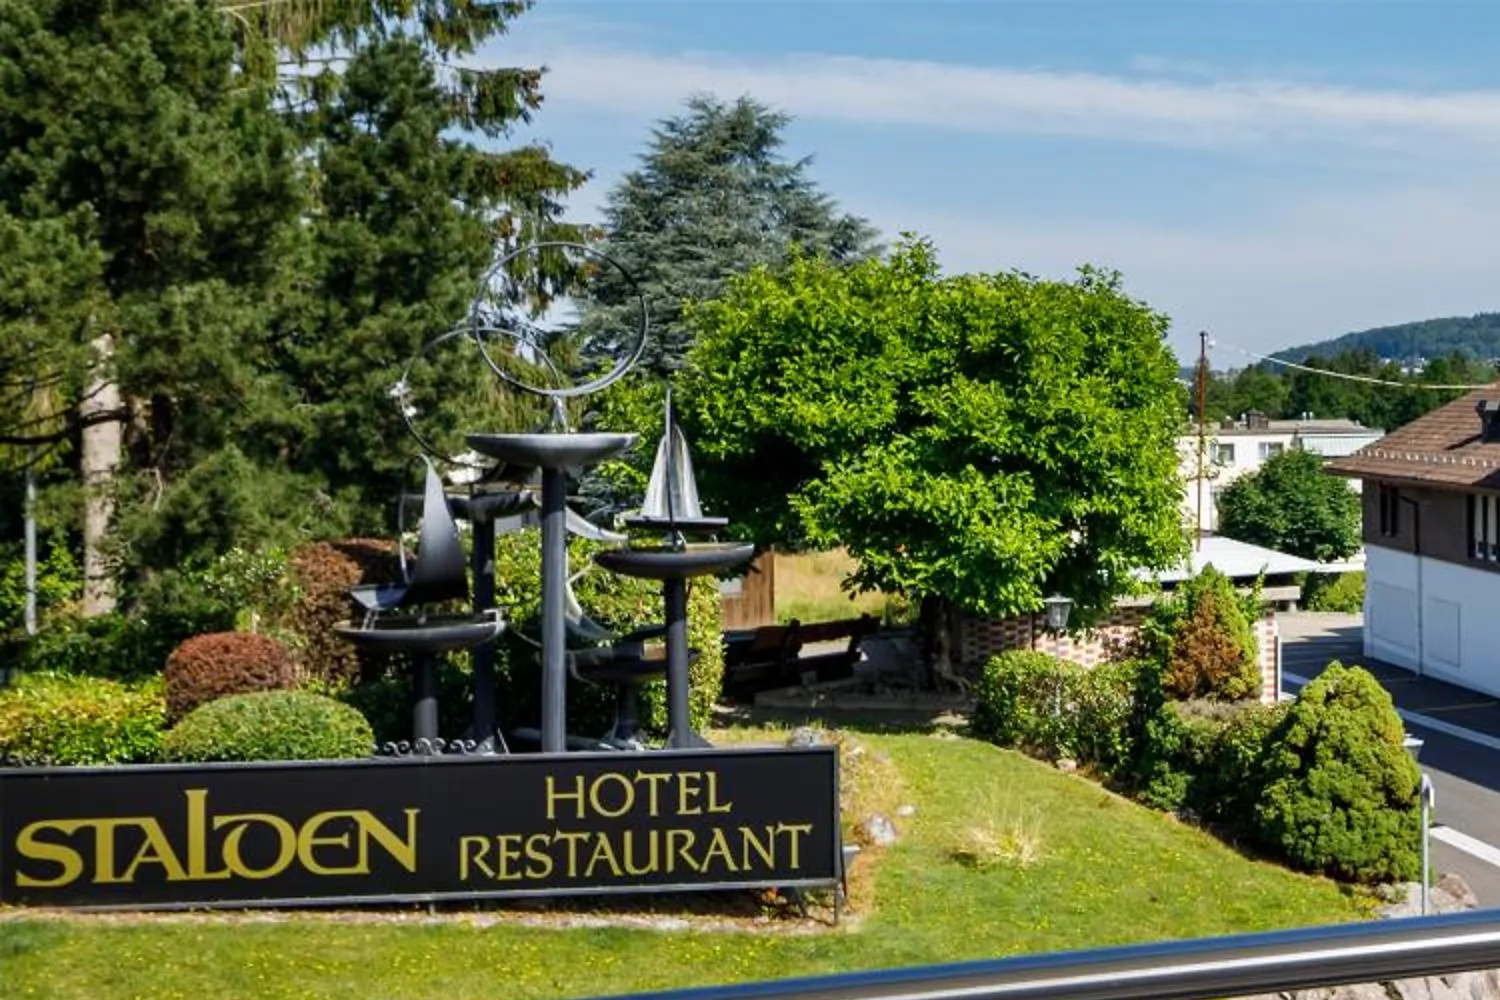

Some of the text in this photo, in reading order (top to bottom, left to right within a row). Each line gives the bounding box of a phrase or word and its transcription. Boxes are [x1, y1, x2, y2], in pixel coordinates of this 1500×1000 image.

[544, 771, 733, 818] HOTEL
[14, 788, 419, 888] STALDEN
[459, 823, 813, 882] RESTAURANT
